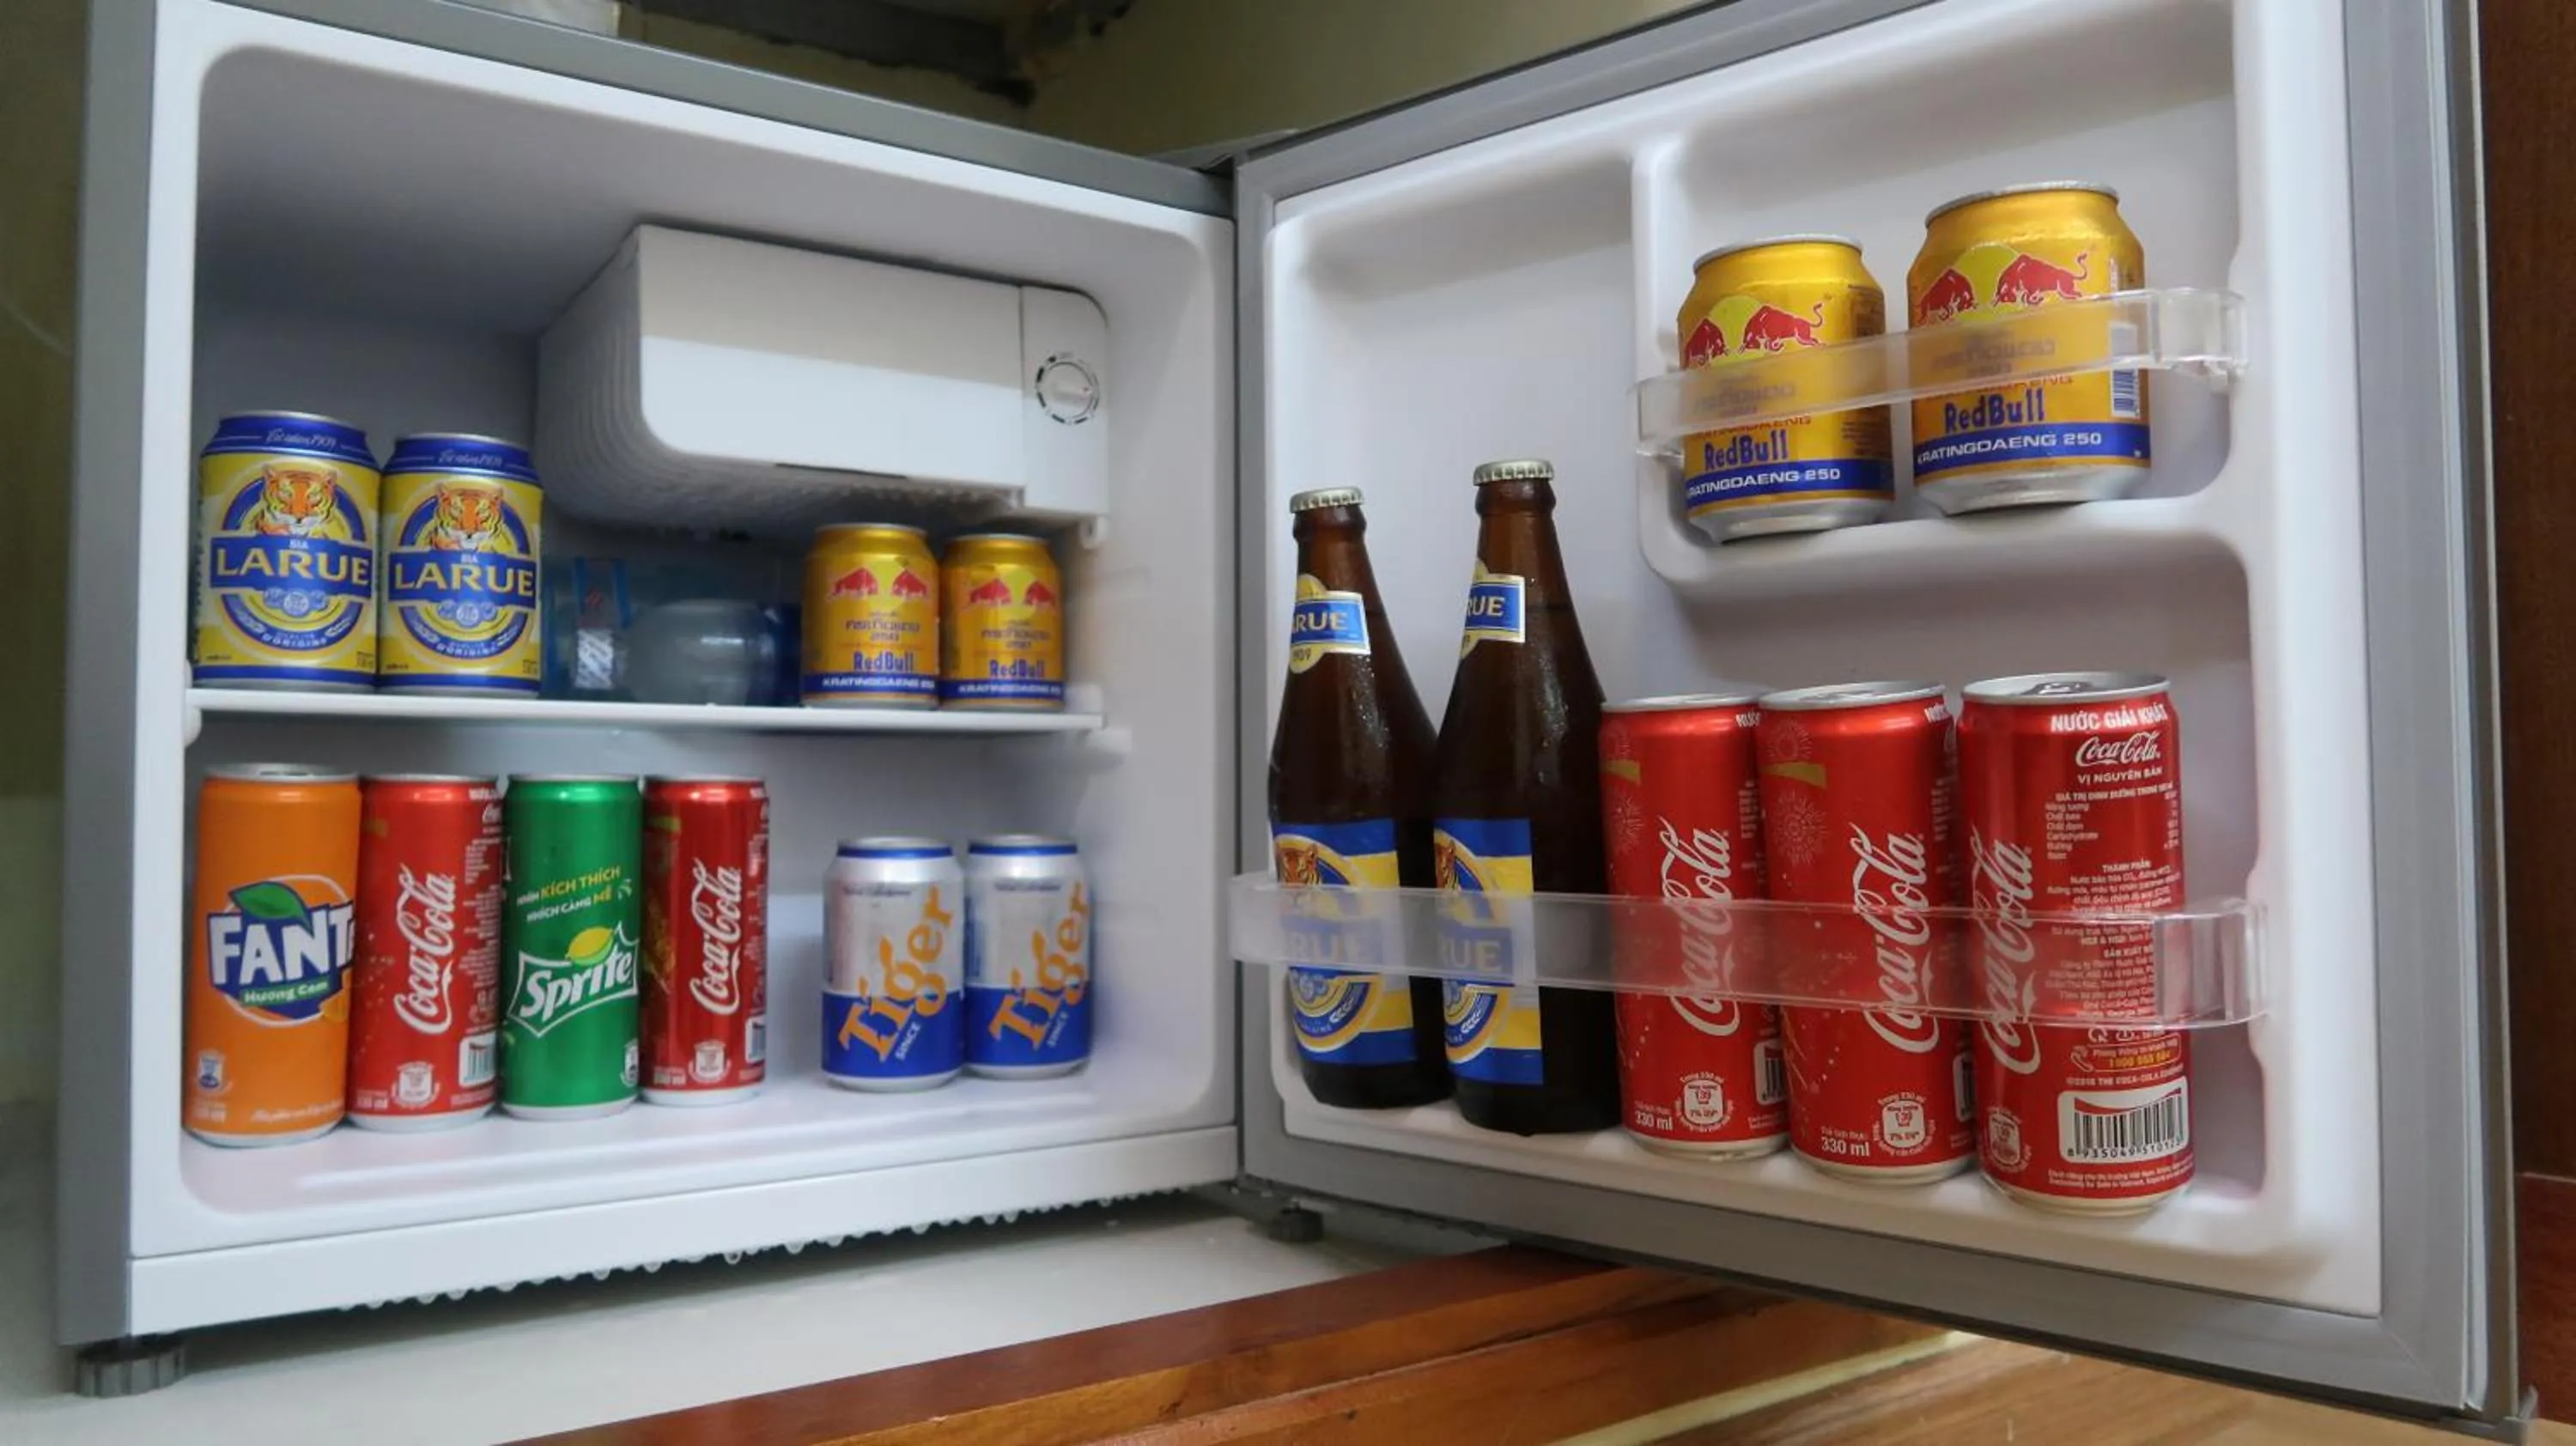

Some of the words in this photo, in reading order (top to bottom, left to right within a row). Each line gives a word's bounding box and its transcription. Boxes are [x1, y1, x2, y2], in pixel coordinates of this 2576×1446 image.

[1944, 387, 2044, 434] RedBull
[1704, 429, 1788, 471] RedBull
[2063, 432, 2102, 446] 250
[1805, 467, 1841, 480] 250
[216, 548, 369, 586] LARUE
[394, 562, 534, 597] LARUE
[853, 651, 914, 672] RedBull
[2075, 730, 2160, 767] Coca-Cola
[394, 862, 457, 1034] Coca-Cola
[690, 857, 743, 1015] Coca-Cola
[1659, 816, 1741, 1036] Coca-Cola
[1848, 822, 1941, 1054] Coca-Cola
[1969, 820, 2041, 1074] Coca-Cola
[519, 943, 633, 1023] Sprite
[838, 884, 953, 1063] Tiger
[989, 880, 1091, 1051] Tiger
[1635, 1109, 1655, 1127] 330
[1656, 1115, 1673, 1131] ml
[1821, 1136, 1847, 1154] 330
[1850, 1141, 1870, 1157] ml
